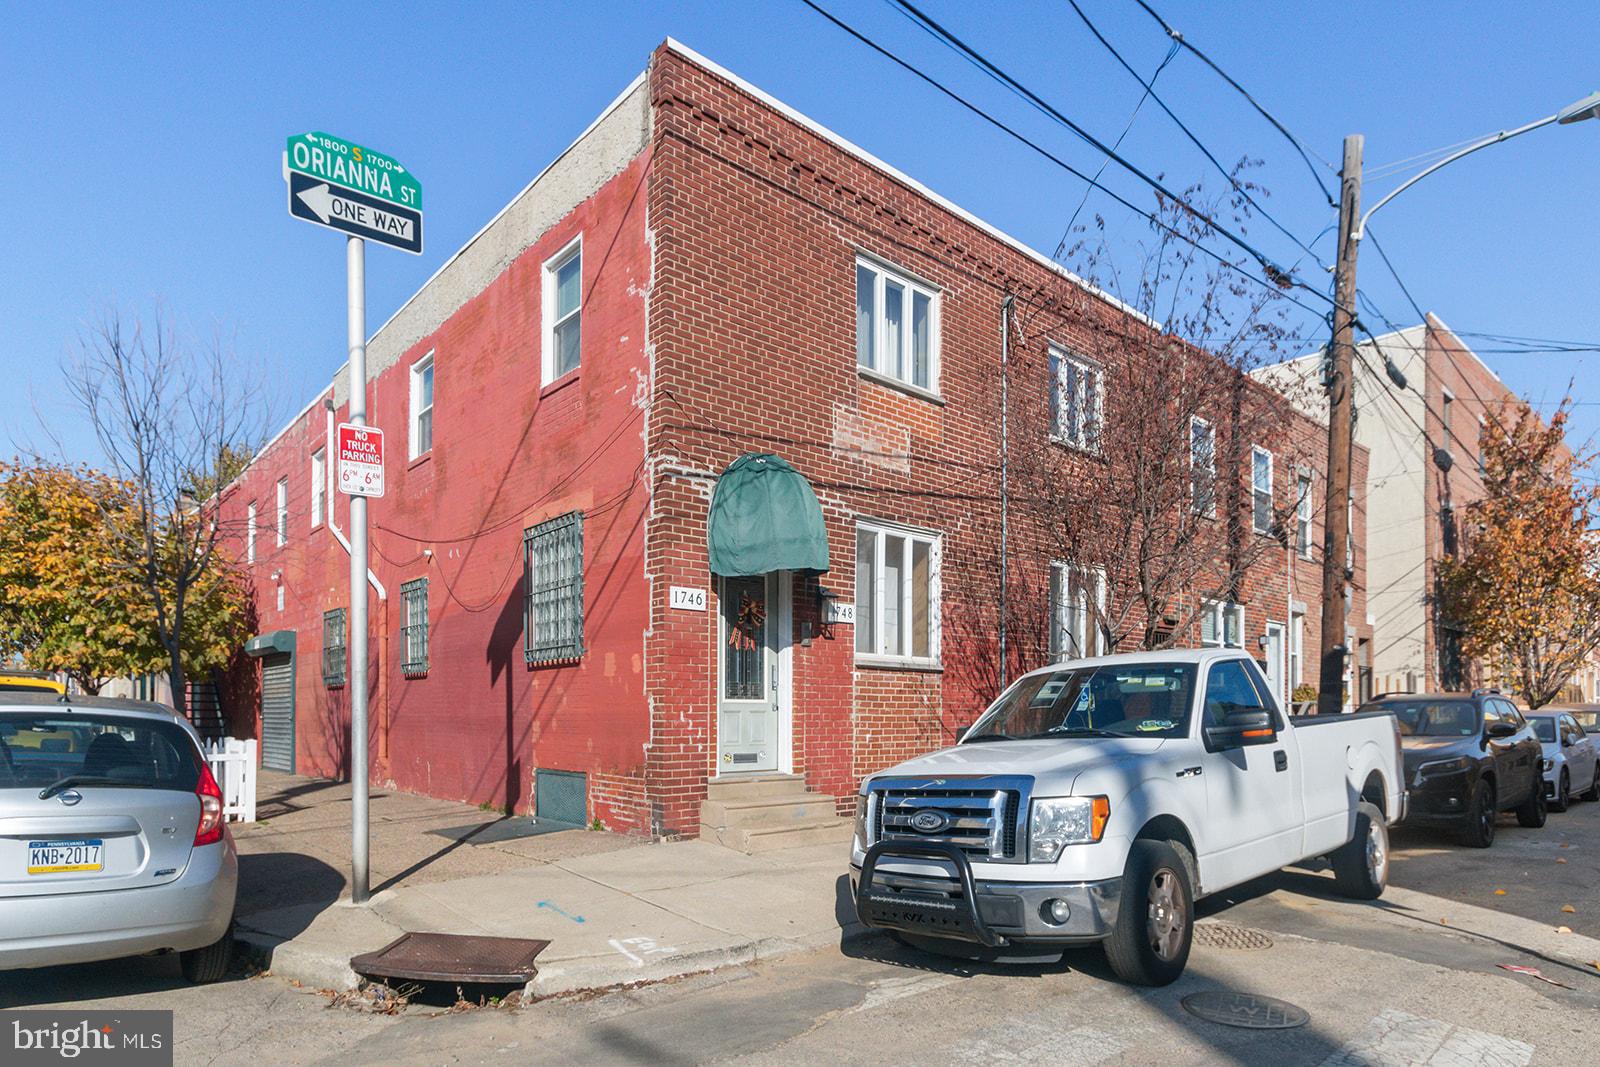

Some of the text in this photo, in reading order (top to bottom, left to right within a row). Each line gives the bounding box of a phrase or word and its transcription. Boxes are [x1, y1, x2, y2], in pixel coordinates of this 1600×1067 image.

[320, 137, 392, 171] 1800 S 1700
[293, 142, 416, 204] ORIANNA ST
[332, 198, 408, 235] ONE WAY
[354, 431, 368, 442] NO
[346, 440, 376, 453] TRUCK
[342, 450, 381, 464] PARKING
[674, 590, 703, 606] 1746
